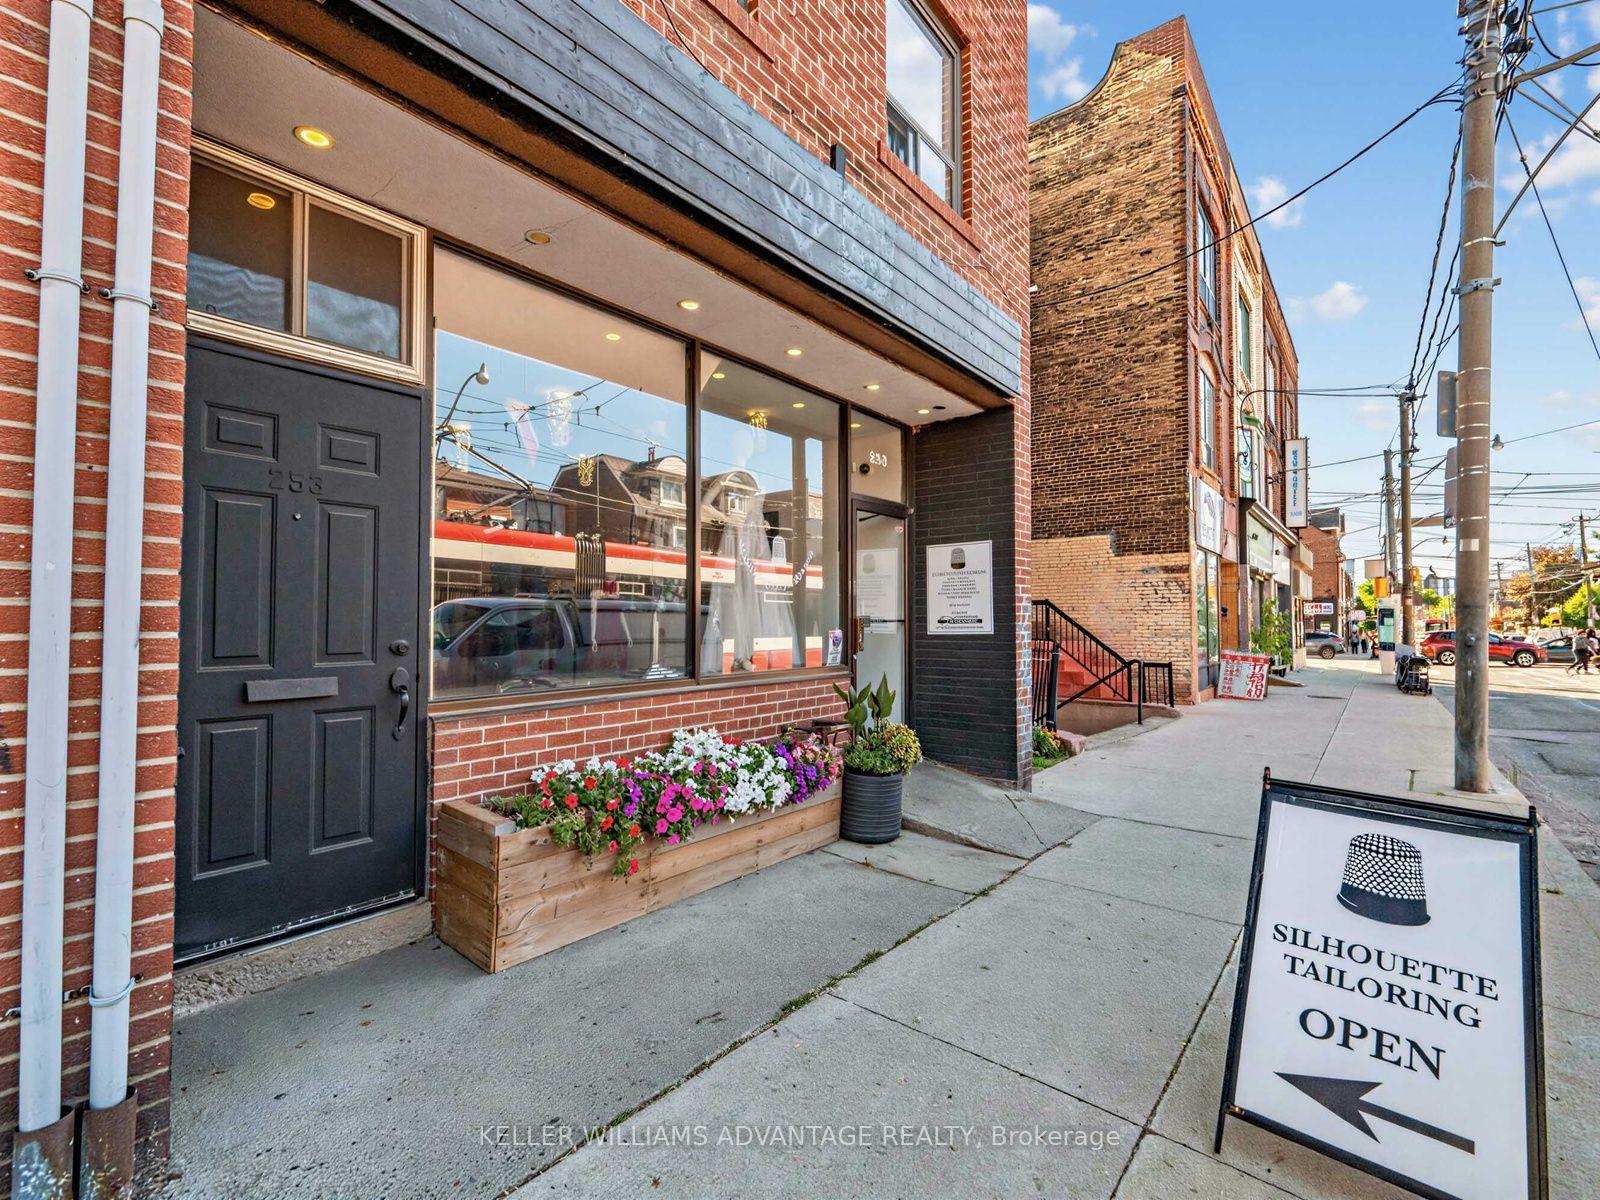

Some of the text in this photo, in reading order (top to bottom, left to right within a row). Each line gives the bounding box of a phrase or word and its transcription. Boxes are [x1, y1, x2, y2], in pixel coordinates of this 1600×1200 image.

[268, 468, 324, 495] 253
[1272, 923, 1499, 1001] SILHOUETTE
[1283, 953, 1482, 1028] TAILORING
[1299, 1008, 1446, 1080] OPEN
